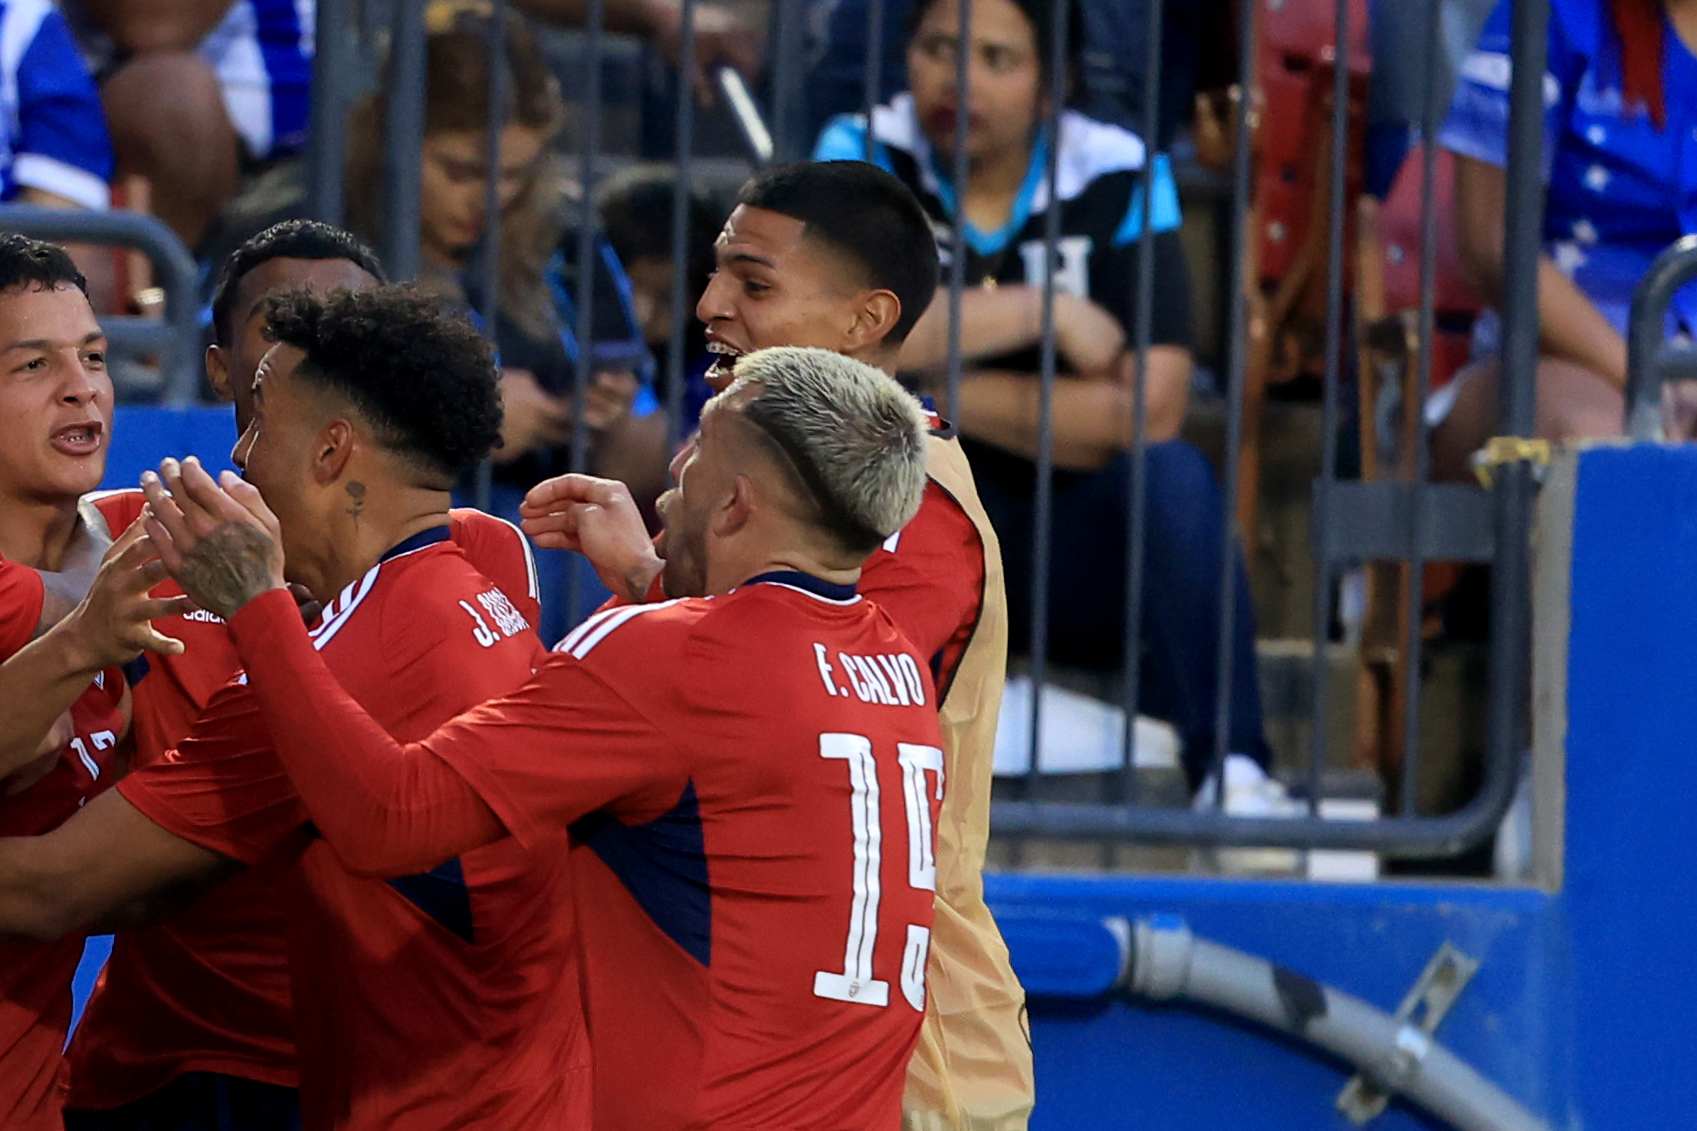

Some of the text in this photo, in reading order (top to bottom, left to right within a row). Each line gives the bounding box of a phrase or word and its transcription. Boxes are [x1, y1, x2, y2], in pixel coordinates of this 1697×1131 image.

[813, 642, 926, 706] F. CALVO
[813, 732, 946, 1013] 15
